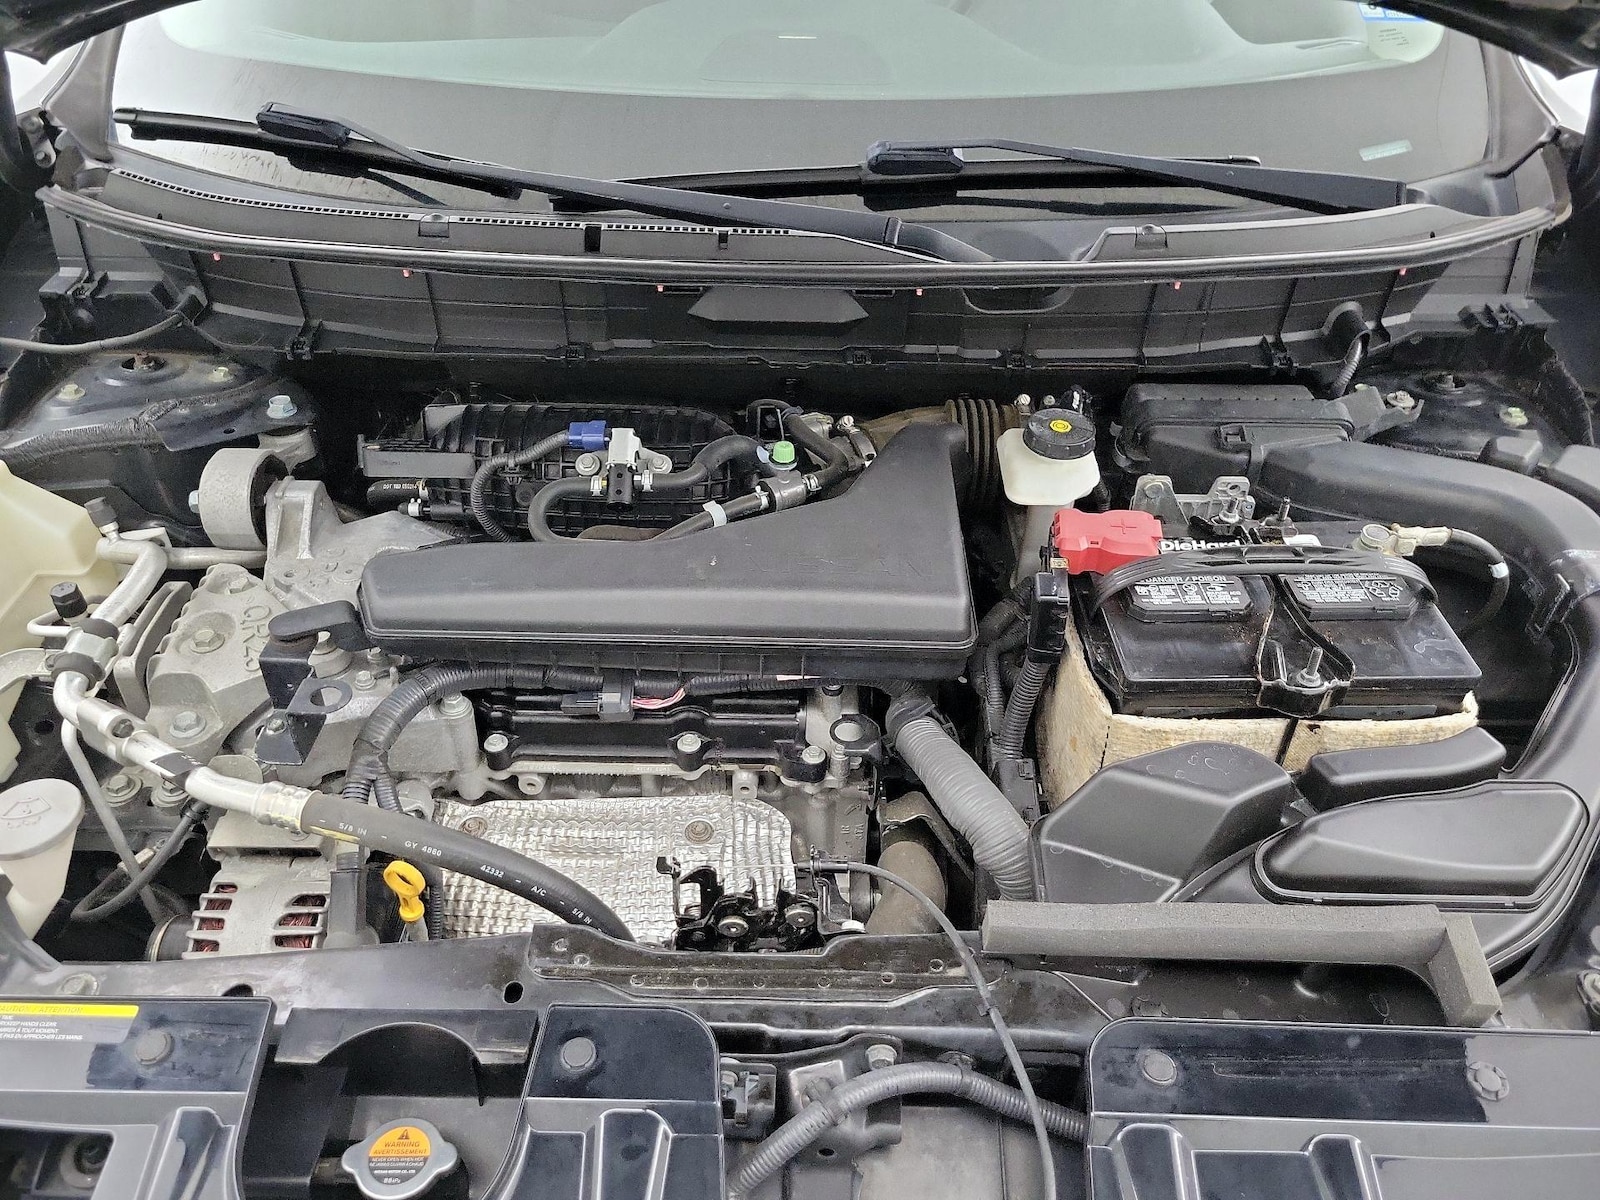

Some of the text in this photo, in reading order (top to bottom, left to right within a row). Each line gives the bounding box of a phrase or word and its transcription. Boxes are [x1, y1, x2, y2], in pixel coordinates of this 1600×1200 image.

[1160, 539, 1241, 551] DieHard
[404, 840, 418, 849] GY
[479, 864, 505, 878] 42332
[530, 885, 547, 897] A/C
